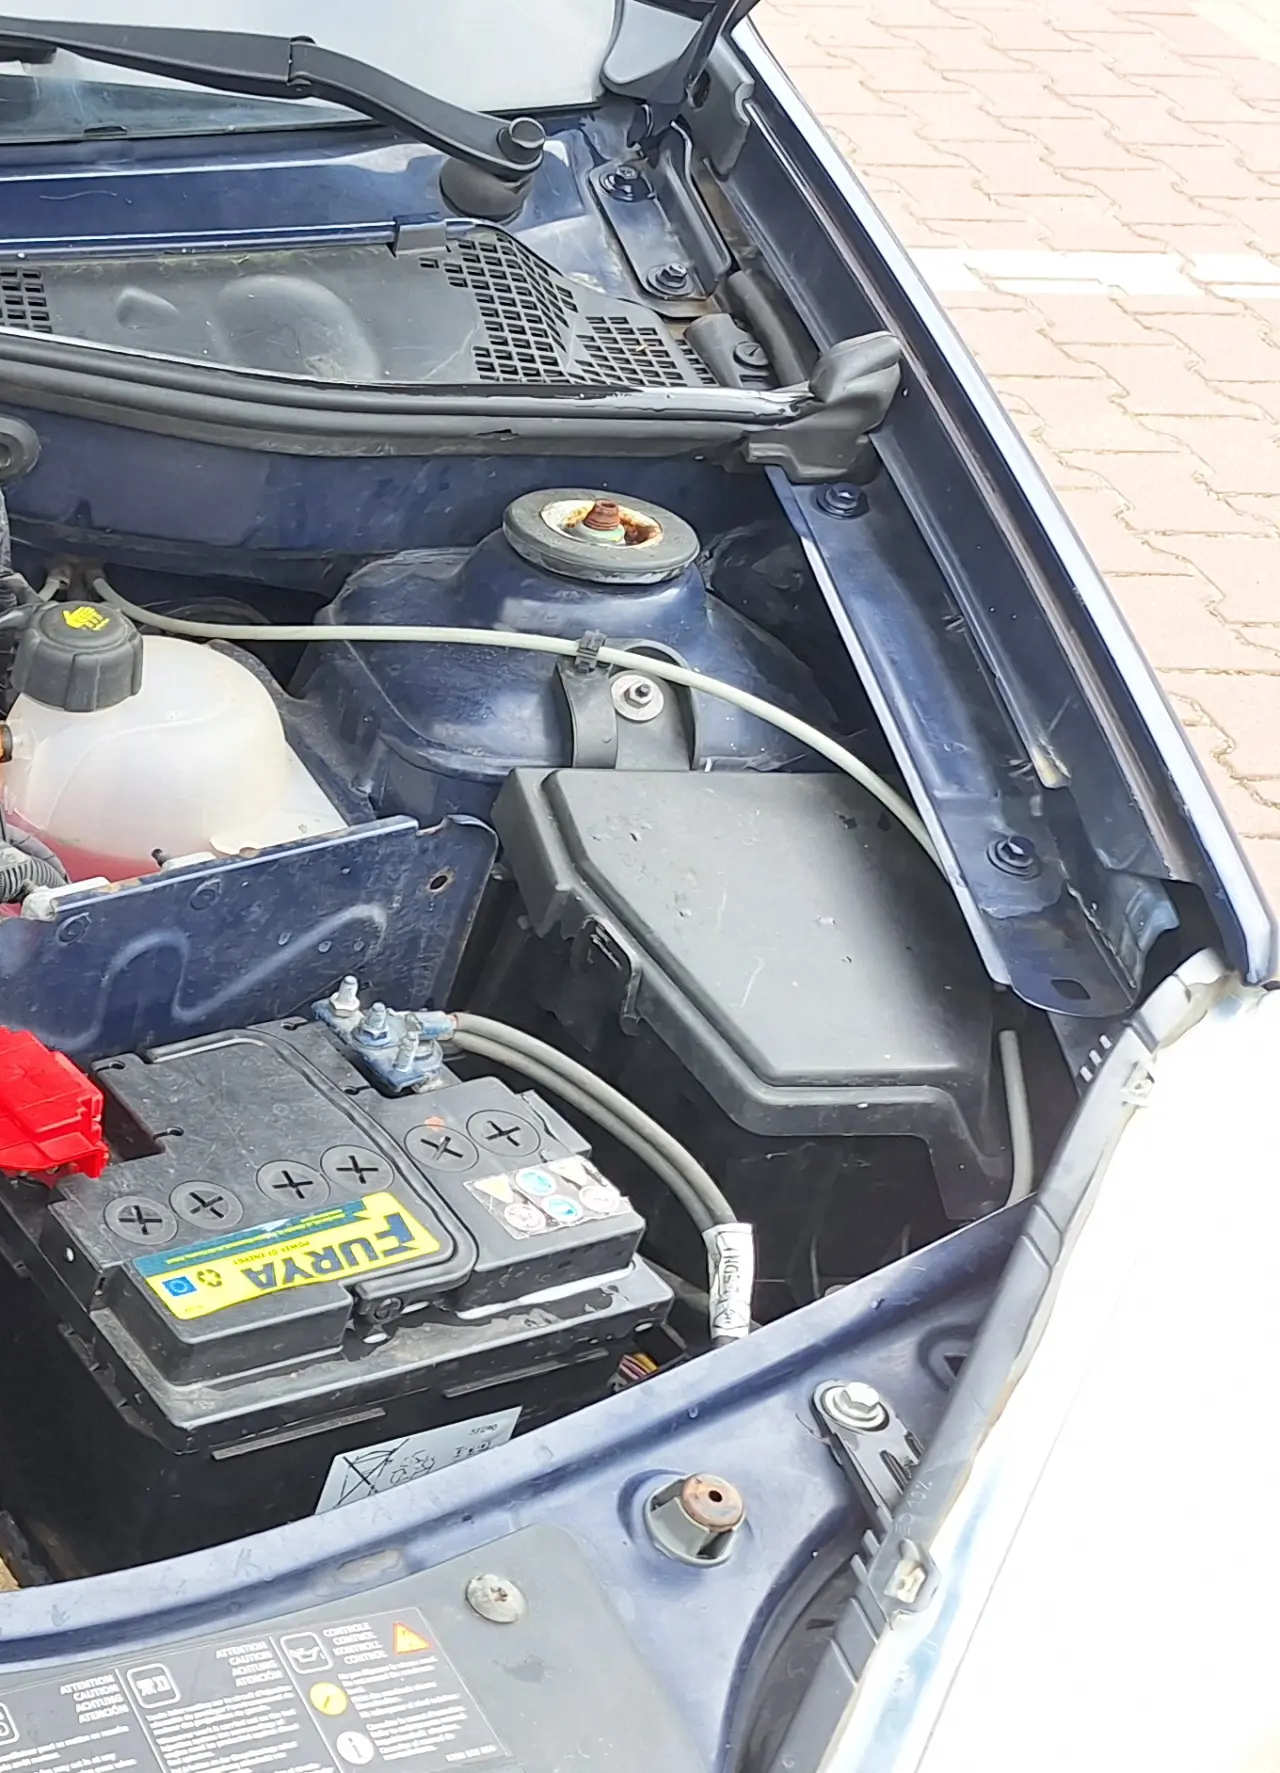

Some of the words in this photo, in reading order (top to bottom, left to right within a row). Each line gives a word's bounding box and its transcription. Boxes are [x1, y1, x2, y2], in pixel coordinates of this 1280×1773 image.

[240, 1212, 419, 1291] FURYA
[60, 1674, 116, 1695] ATTENTION
[73, 1684, 120, 1702] CAUTION
